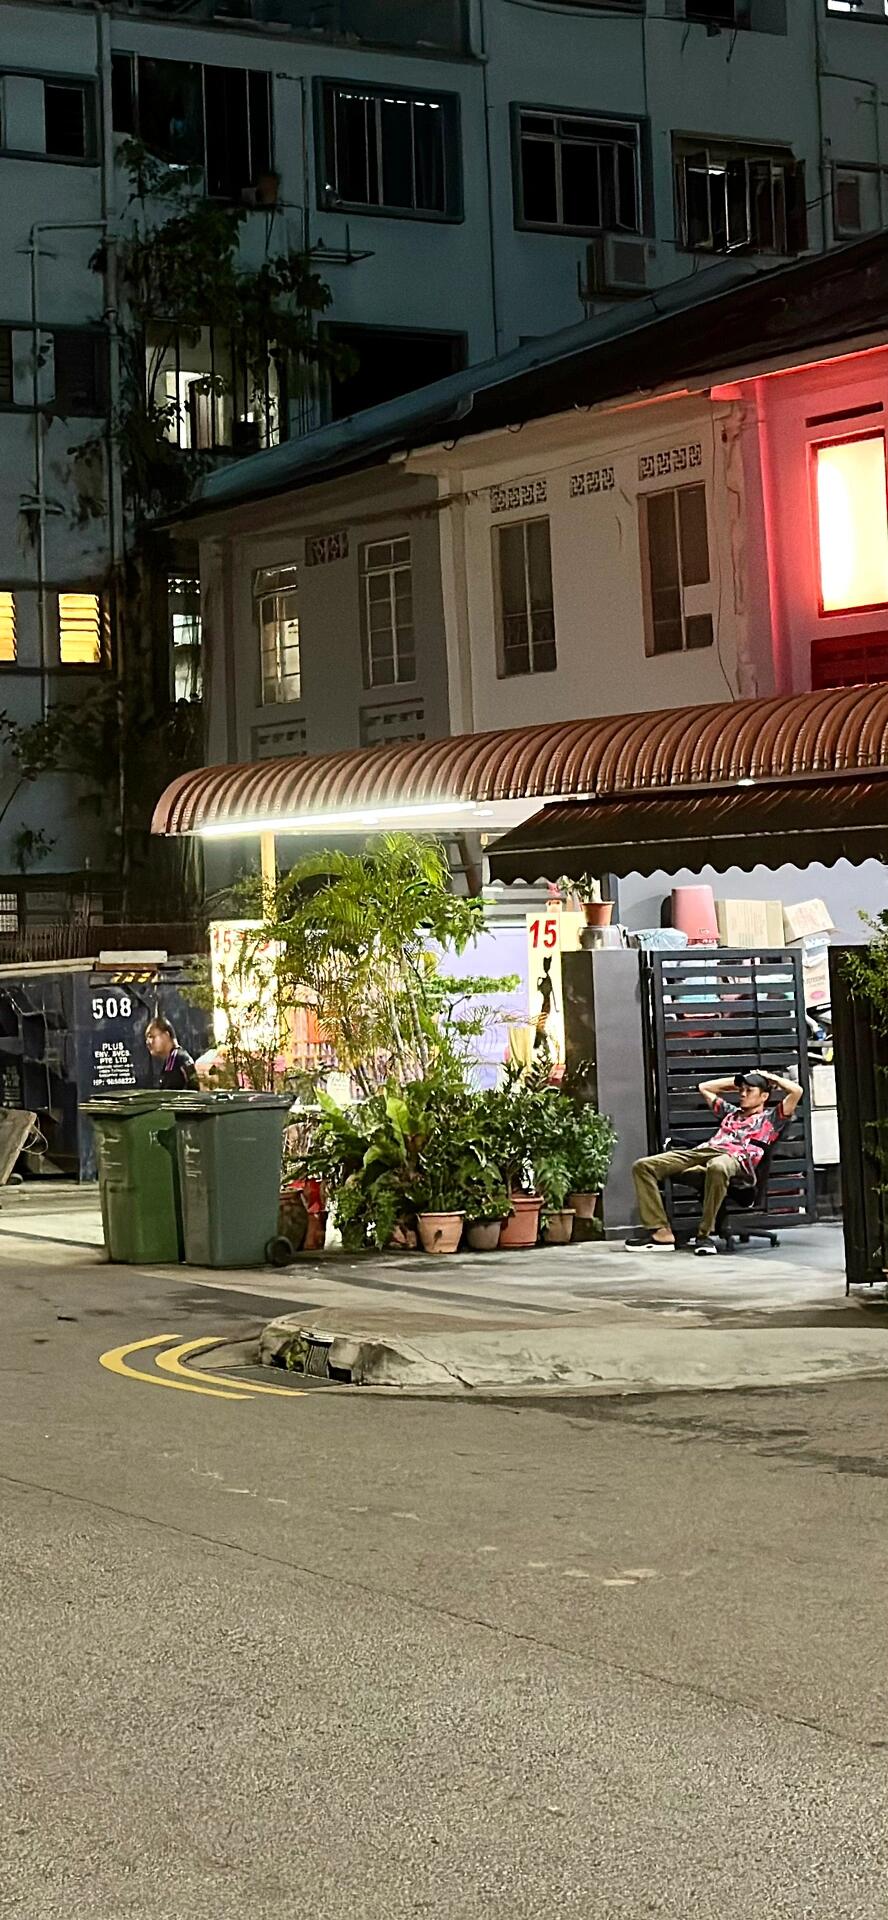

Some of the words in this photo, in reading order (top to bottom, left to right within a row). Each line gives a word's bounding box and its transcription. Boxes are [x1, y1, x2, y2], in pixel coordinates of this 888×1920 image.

[529, 919, 557, 948] 15
[92, 997, 132, 1020] 508
[102, 1042, 124, 1051] PLUS
[115, 1056, 128, 1064] LTD
